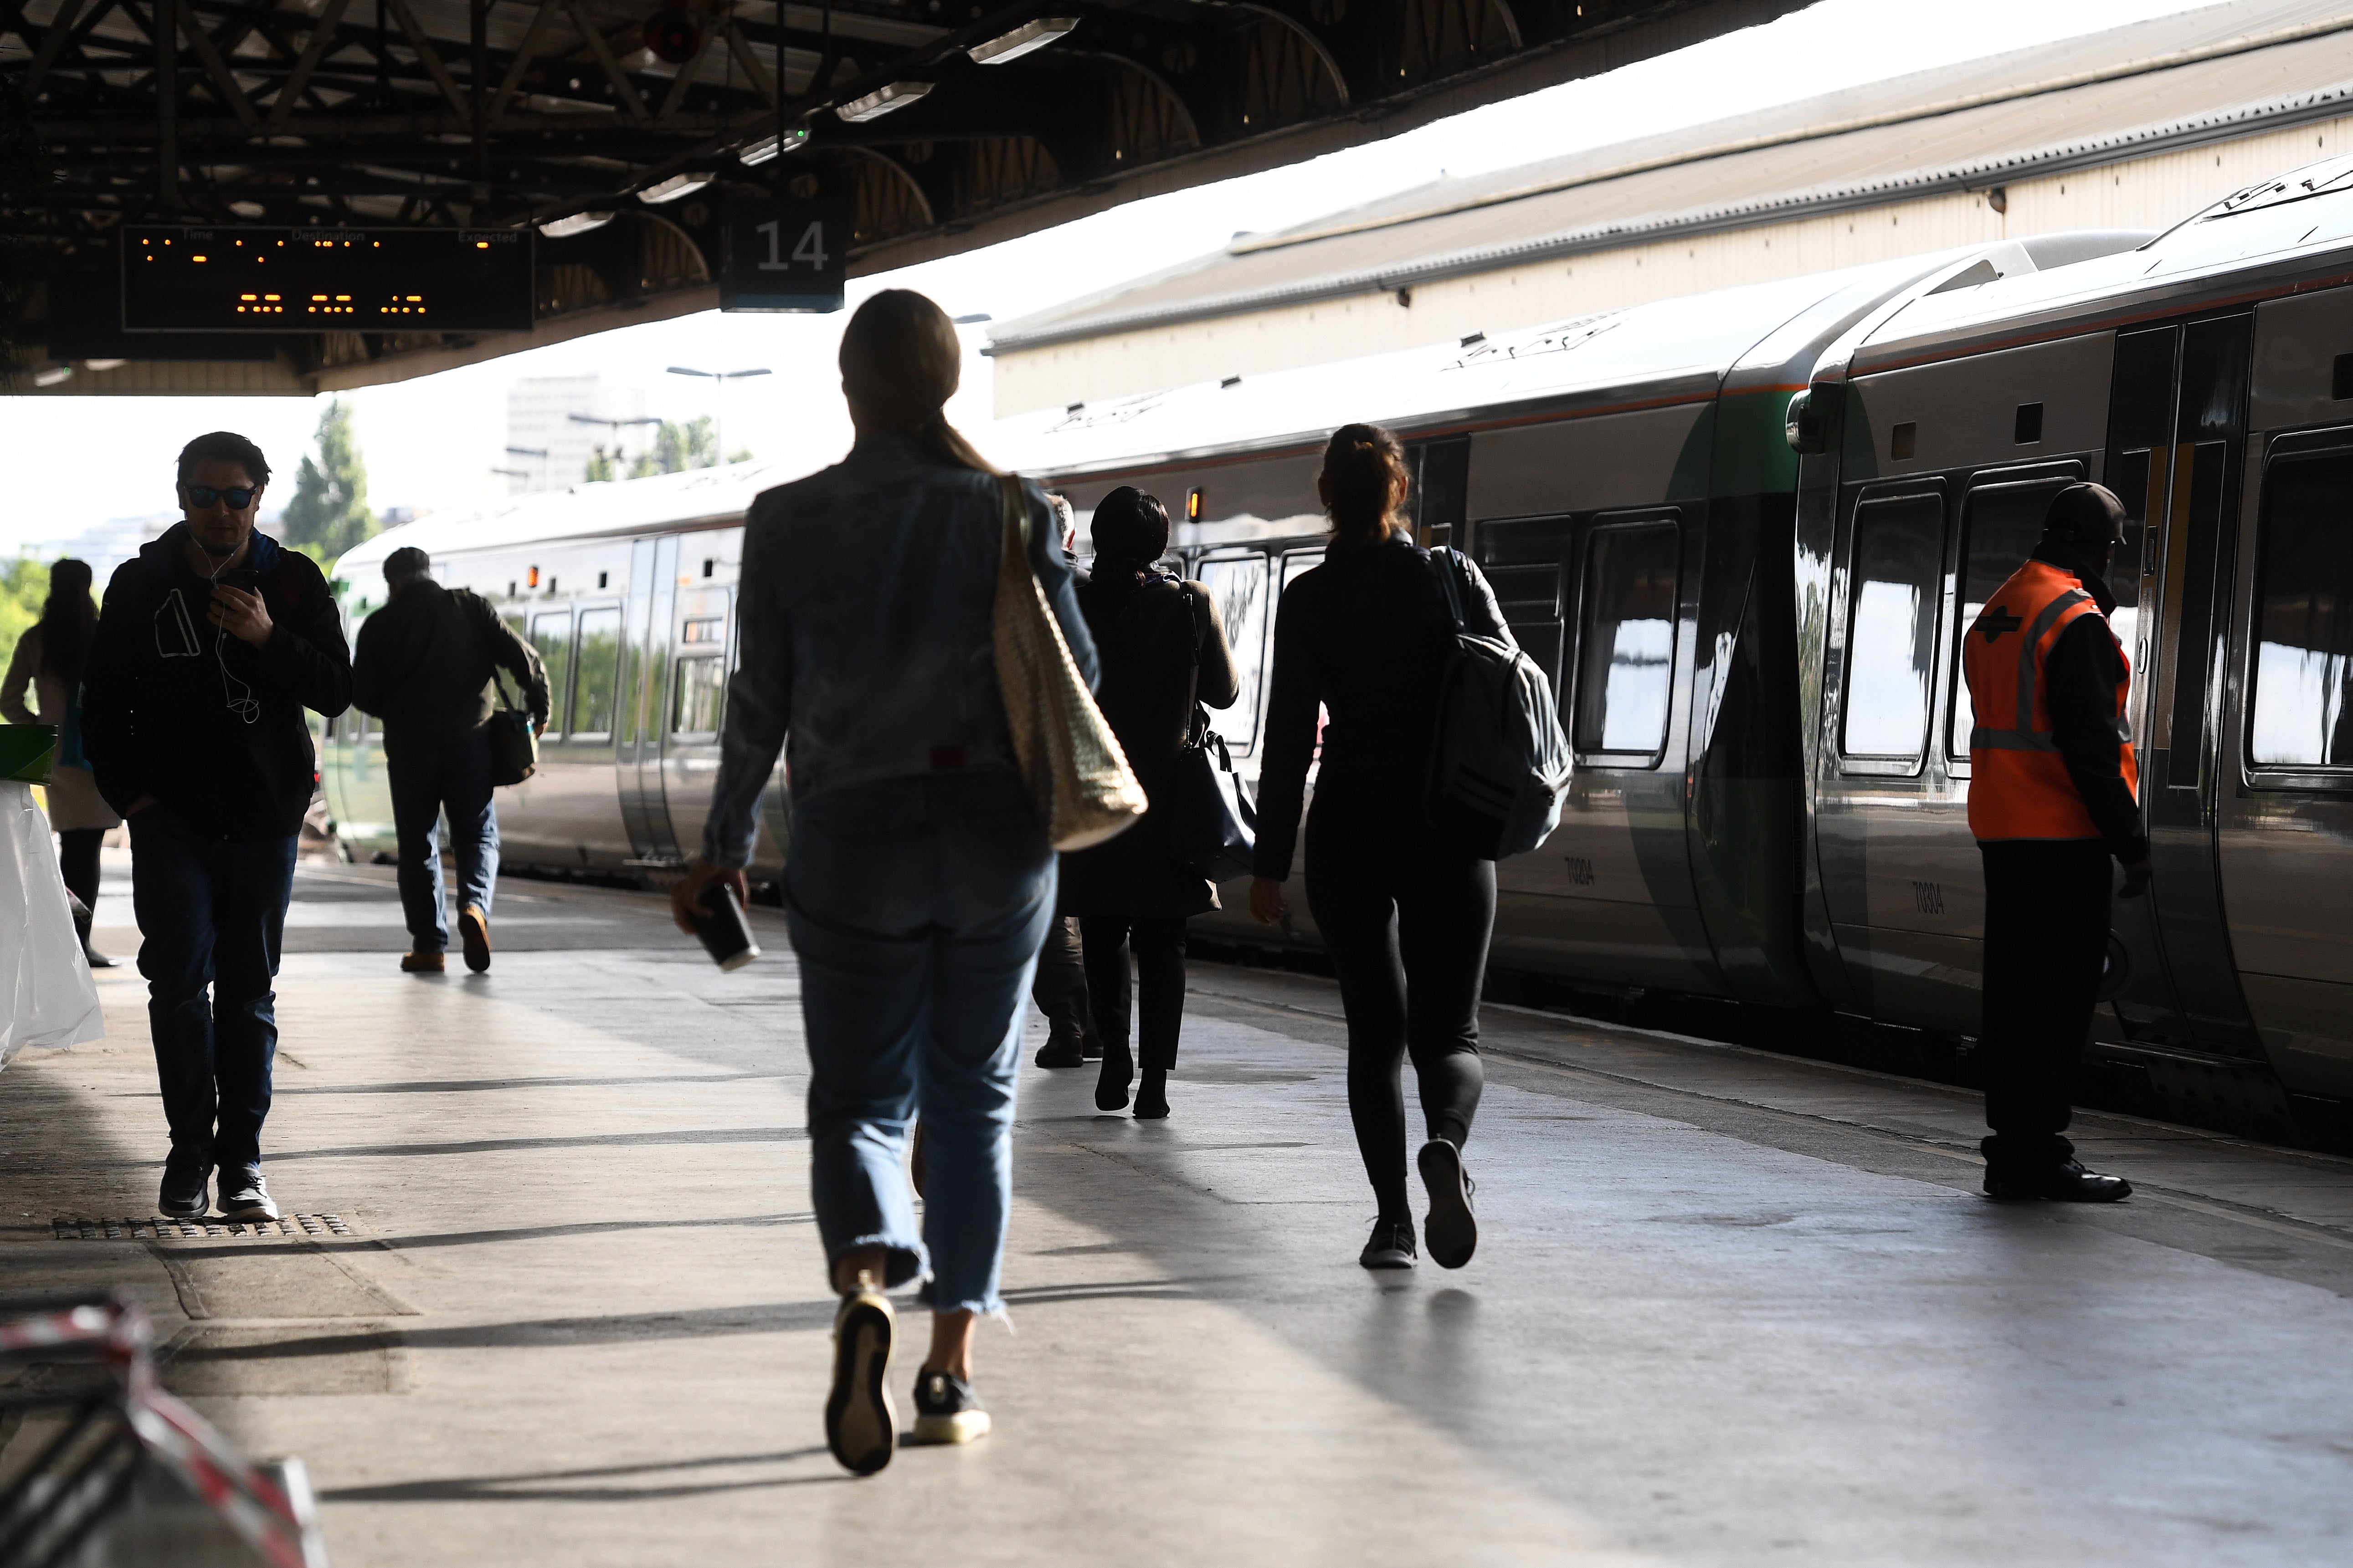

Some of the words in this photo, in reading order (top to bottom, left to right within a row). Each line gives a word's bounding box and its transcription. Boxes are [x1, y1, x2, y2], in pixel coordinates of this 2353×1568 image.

[182, 229, 214, 241] Time
[292, 229, 365, 242] Destination
[458, 230, 518, 243] Expected
[755, 220, 829, 271] 14
[1912, 881, 1944, 915] 70304
